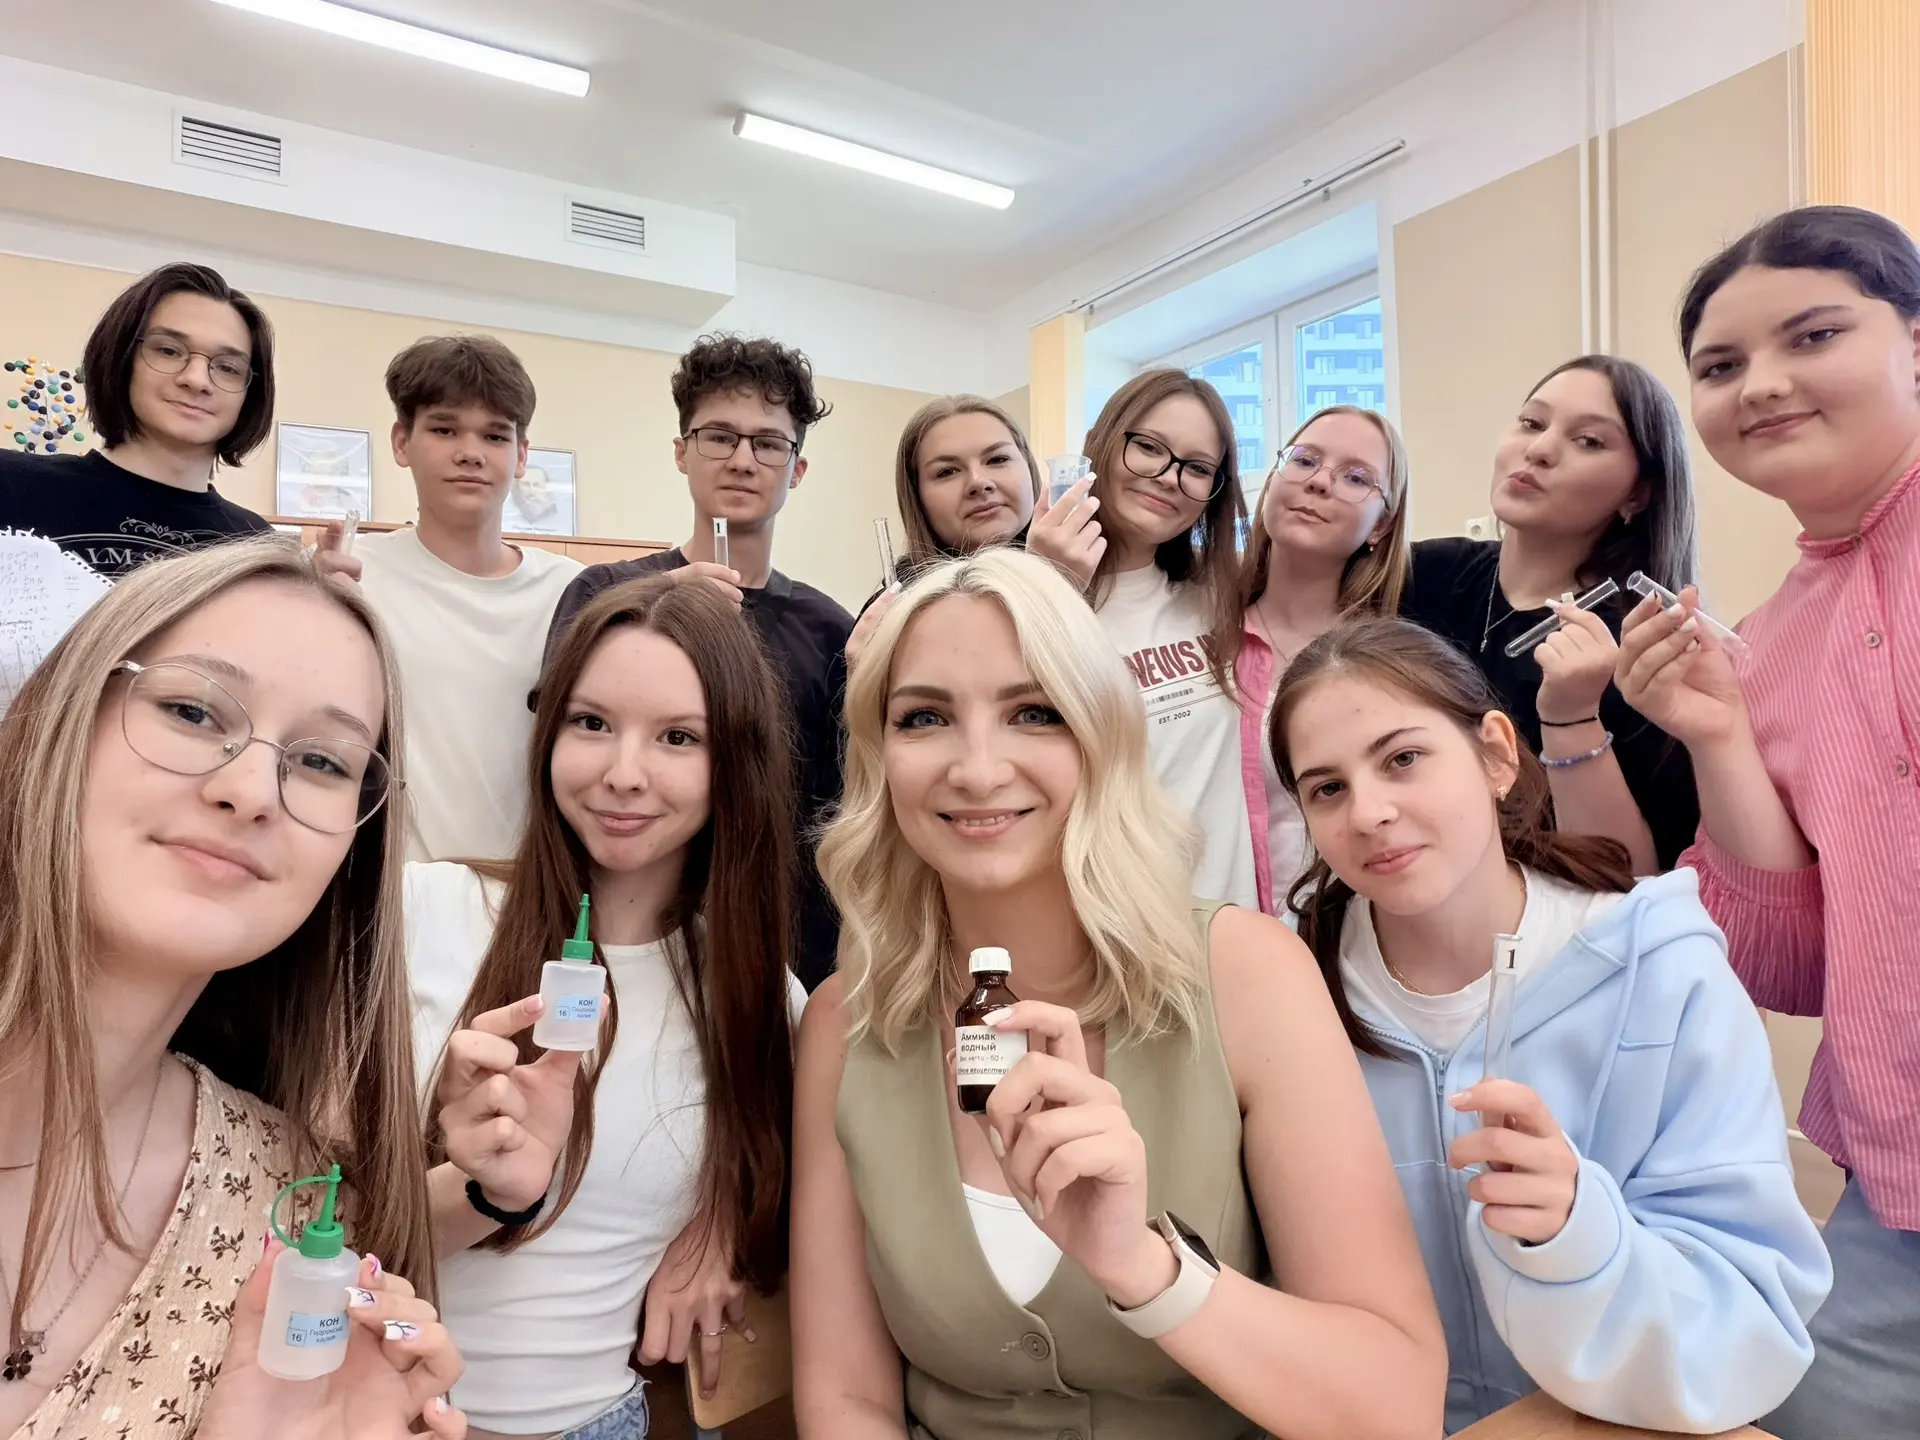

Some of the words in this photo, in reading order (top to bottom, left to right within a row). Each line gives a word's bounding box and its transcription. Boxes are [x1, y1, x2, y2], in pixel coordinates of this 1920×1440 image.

[715, 522, 721, 533] 1
[1122, 640, 1206, 688] NEWS
[1158, 715, 1172, 725] EST.
[1173, 709, 1192, 721] 2002
[1506, 948, 1516, 969] 1
[559, 1009, 567, 1017] 16
[961, 1033, 996, 1041] Аммиак
[961, 1043, 996, 1052] водный
[291, 1333, 302, 1342] 16
